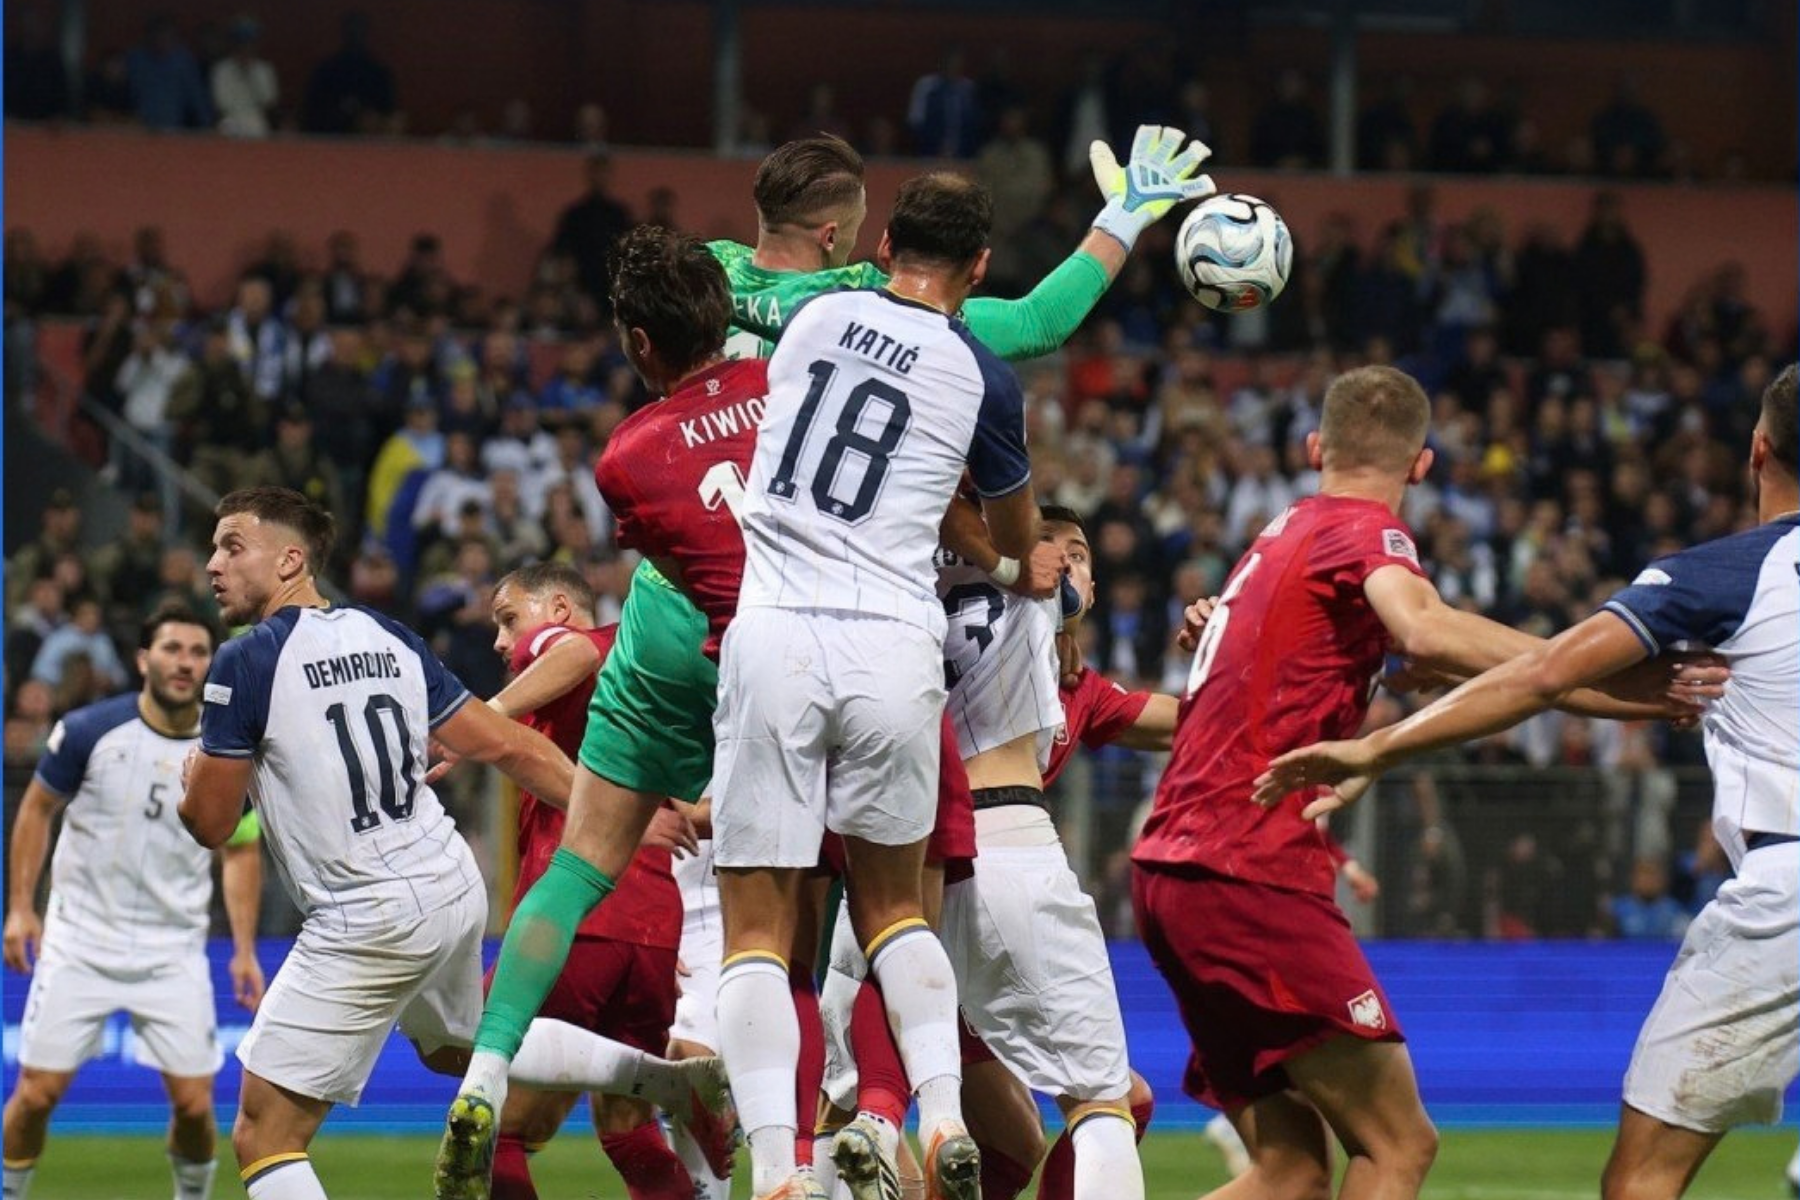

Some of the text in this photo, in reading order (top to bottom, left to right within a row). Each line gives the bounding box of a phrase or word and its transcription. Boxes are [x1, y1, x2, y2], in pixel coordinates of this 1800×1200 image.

[838, 321, 920, 375] KATIĆ
[679, 397, 769, 449] KIWIO
[767, 358, 913, 526] 18
[325, 694, 417, 835] 10
[144, 782, 168, 820] 5
